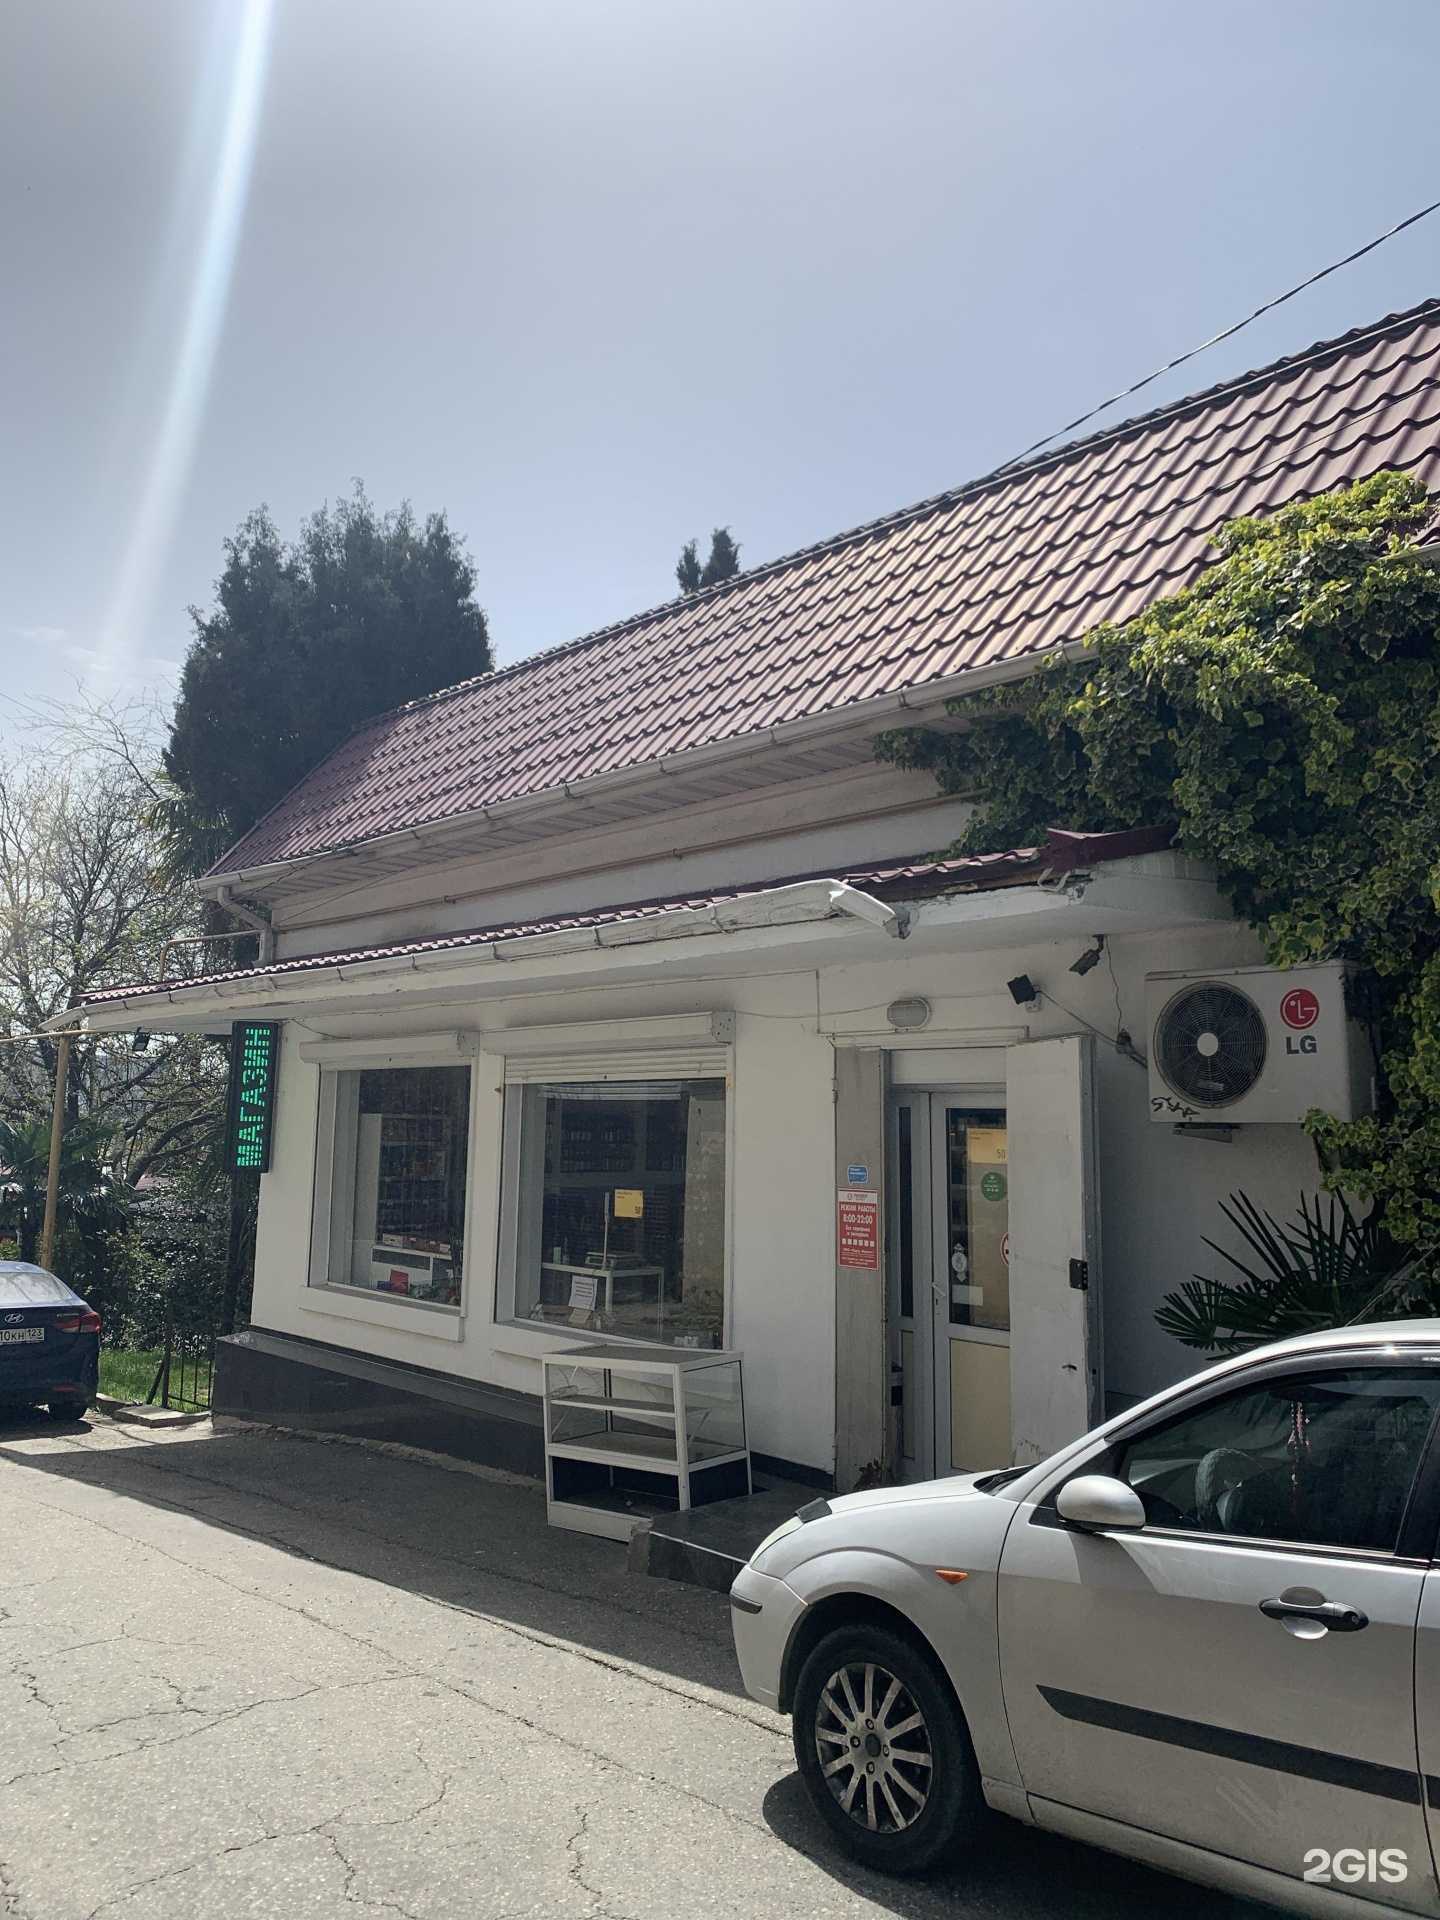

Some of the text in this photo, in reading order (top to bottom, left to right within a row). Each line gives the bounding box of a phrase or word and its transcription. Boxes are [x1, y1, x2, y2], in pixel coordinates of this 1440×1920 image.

[1285, 1035, 1317, 1054] LG
[237, 1028, 271, 1167] МАГАЗИН
[27, 1328, 42, 1338] 123
